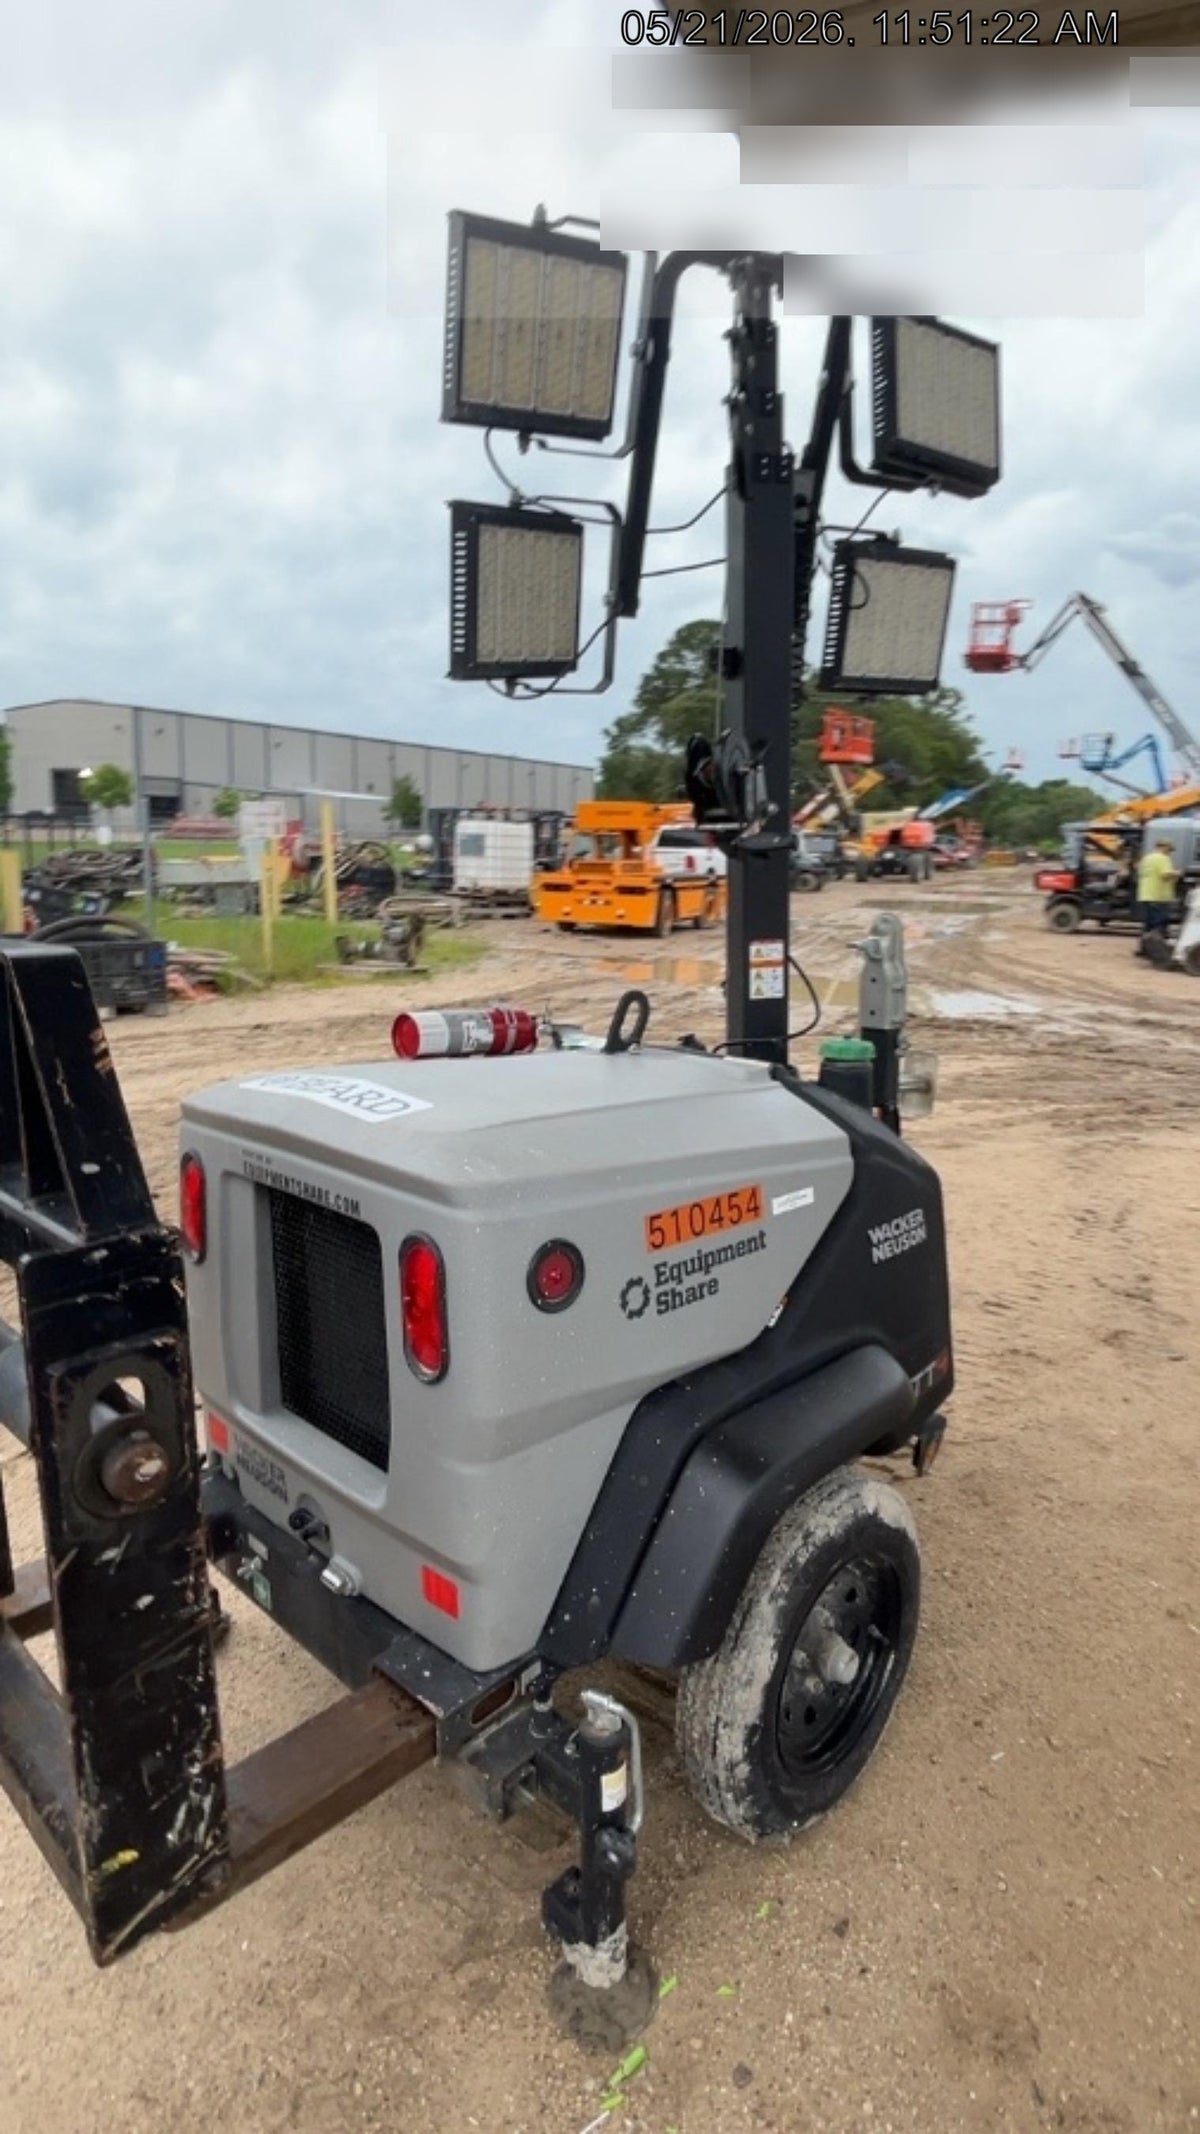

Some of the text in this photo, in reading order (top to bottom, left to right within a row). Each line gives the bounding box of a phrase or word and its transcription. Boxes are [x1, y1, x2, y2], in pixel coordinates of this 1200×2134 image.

[649, 1185, 760, 1250] 510454
[867, 1208, 925, 1245] WACKER
[653, 1229, 767, 1287] Equipment
[871, 1225, 928, 1265] NEUSON
[656, 1277, 720, 1316] Share
